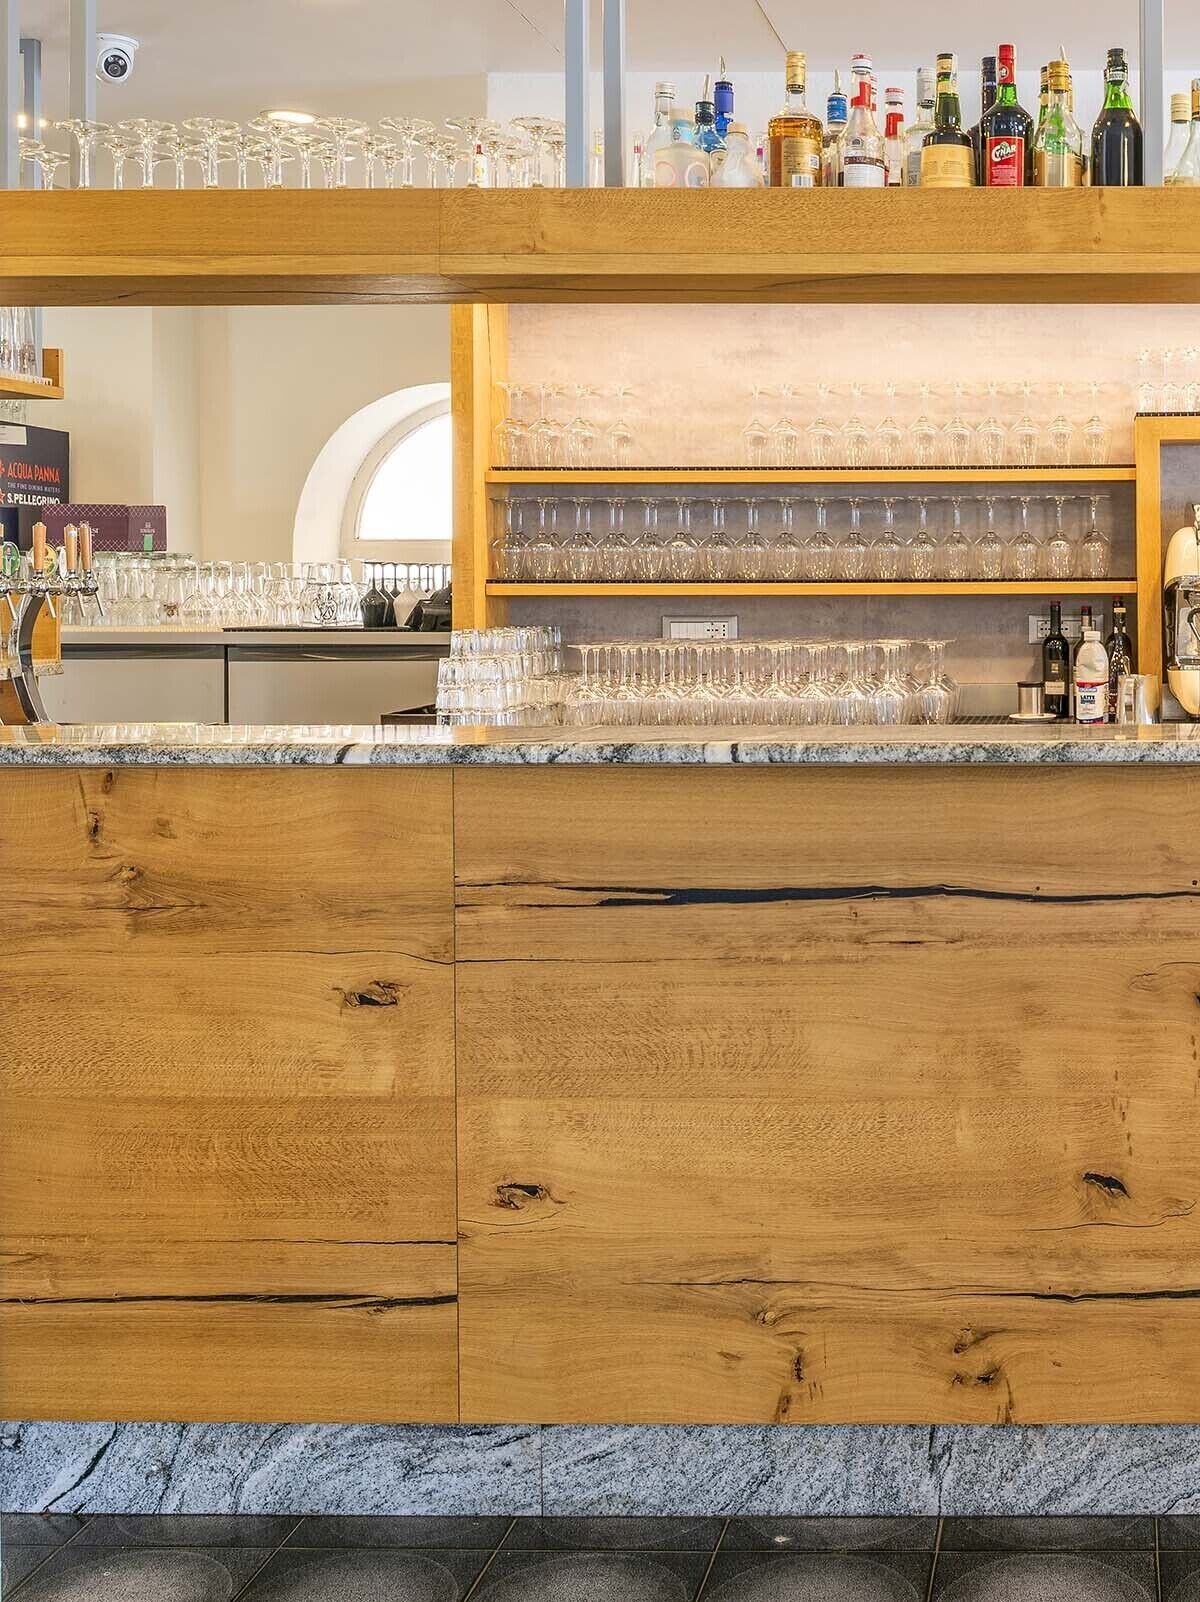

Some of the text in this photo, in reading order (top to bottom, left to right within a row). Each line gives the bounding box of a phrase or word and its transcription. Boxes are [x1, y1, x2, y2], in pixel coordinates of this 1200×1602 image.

[8, 462, 60, 483] ACQUA PANNA
[7, 492, 61, 506] S.PELLEGRINO
